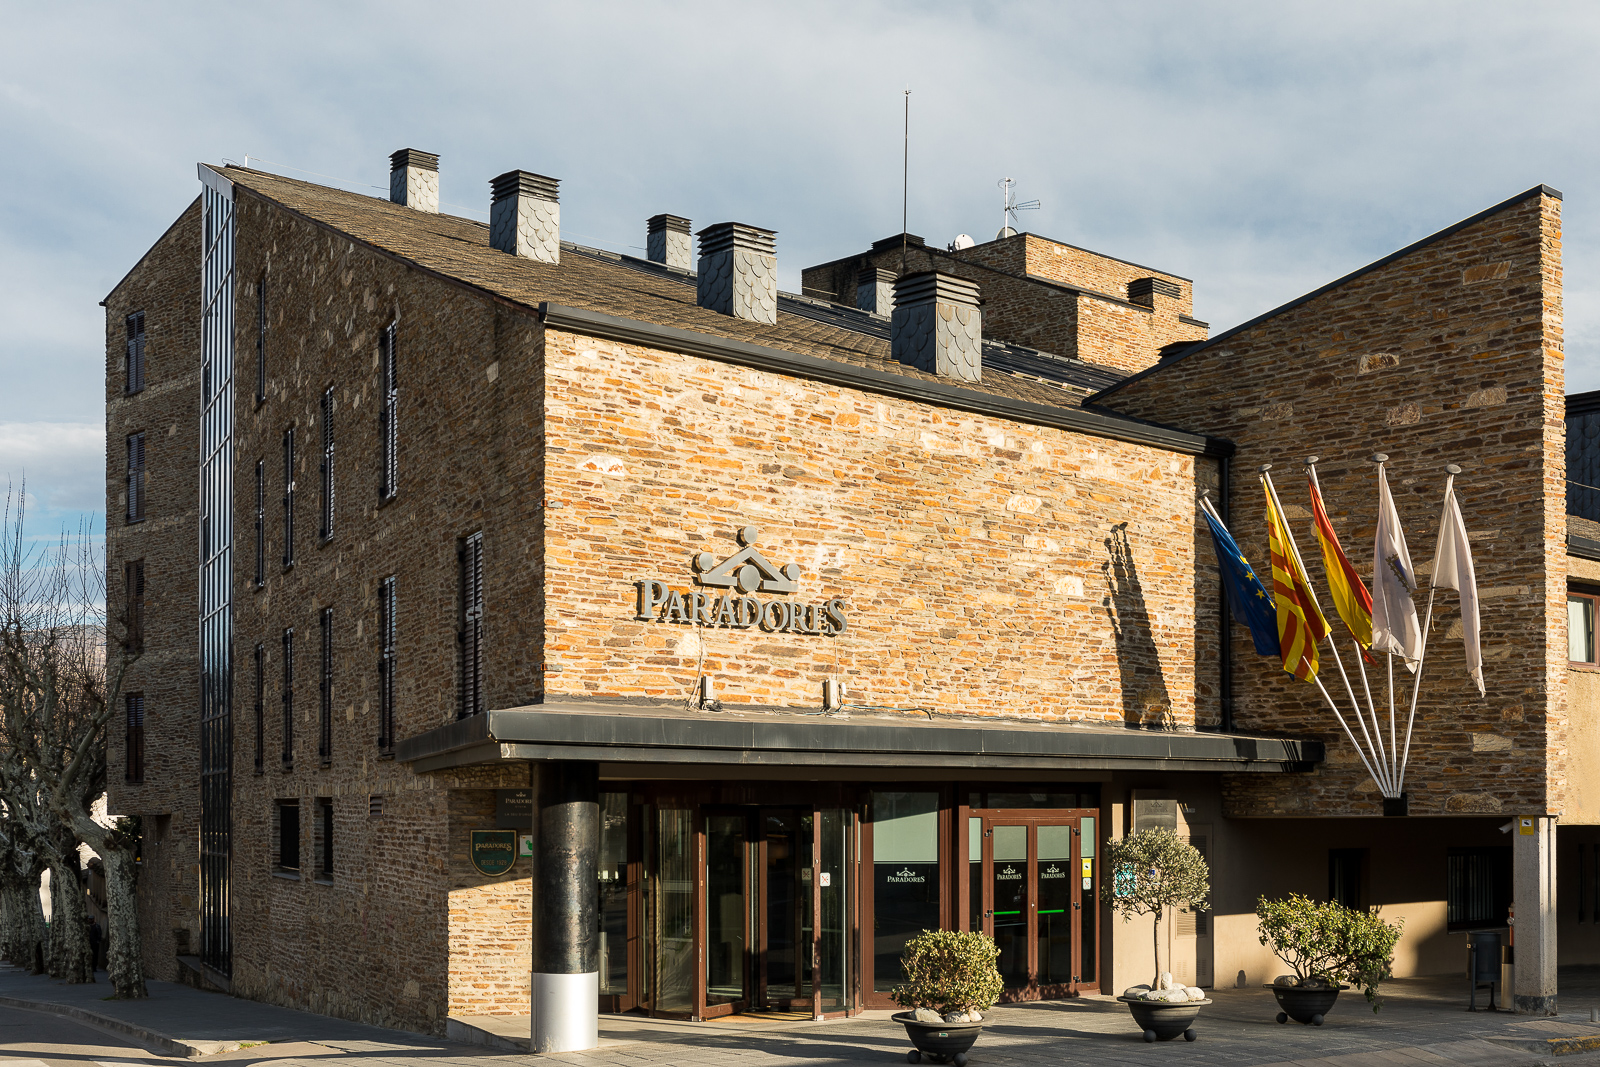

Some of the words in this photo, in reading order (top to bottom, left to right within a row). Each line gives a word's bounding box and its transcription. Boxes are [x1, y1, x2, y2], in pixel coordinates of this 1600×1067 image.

[636, 579, 848, 635] PARADORES
[475, 842, 512, 852] PARADORES
[887, 875, 926, 883] PARADORES
